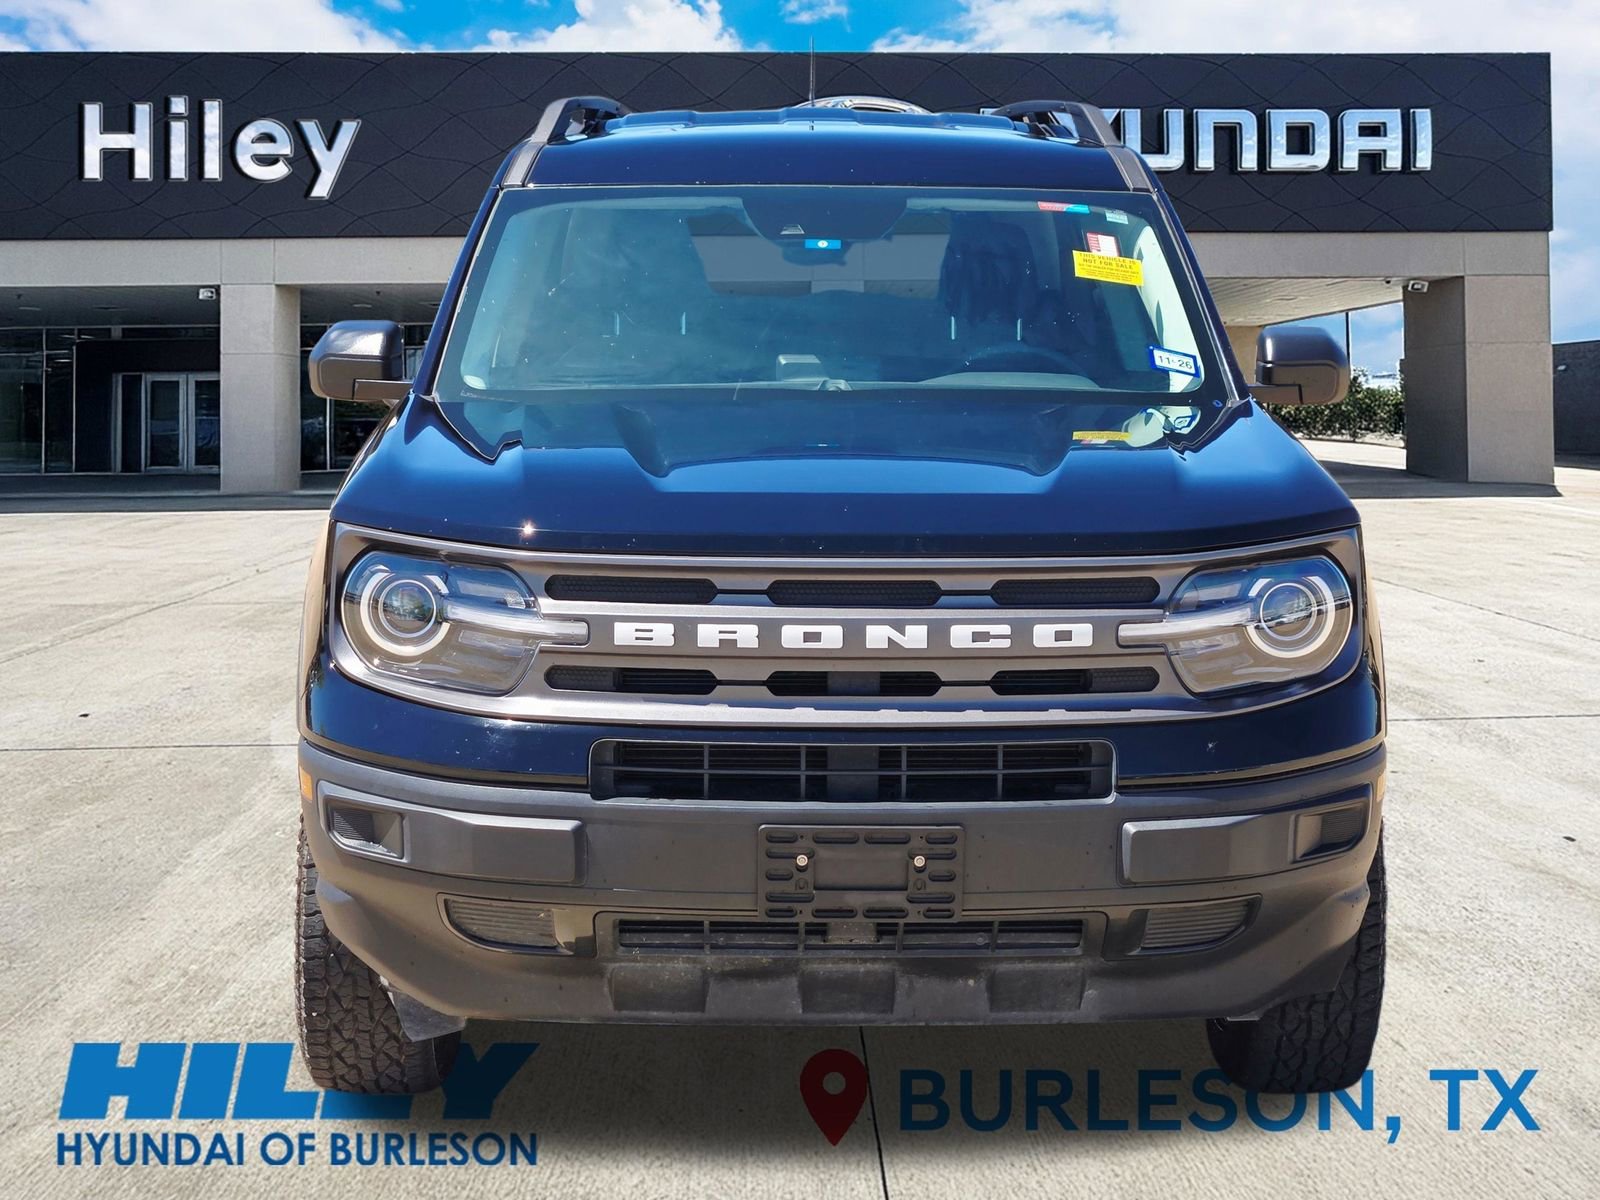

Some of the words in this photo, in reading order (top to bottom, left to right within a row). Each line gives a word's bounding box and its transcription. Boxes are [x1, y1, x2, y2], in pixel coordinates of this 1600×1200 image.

[80, 95, 362, 199] Hiley
[979, 107, 1432, 172] UNDAI
[1158, 355, 1192, 370] 11-26
[613, 622, 1094, 649] BRONCO
